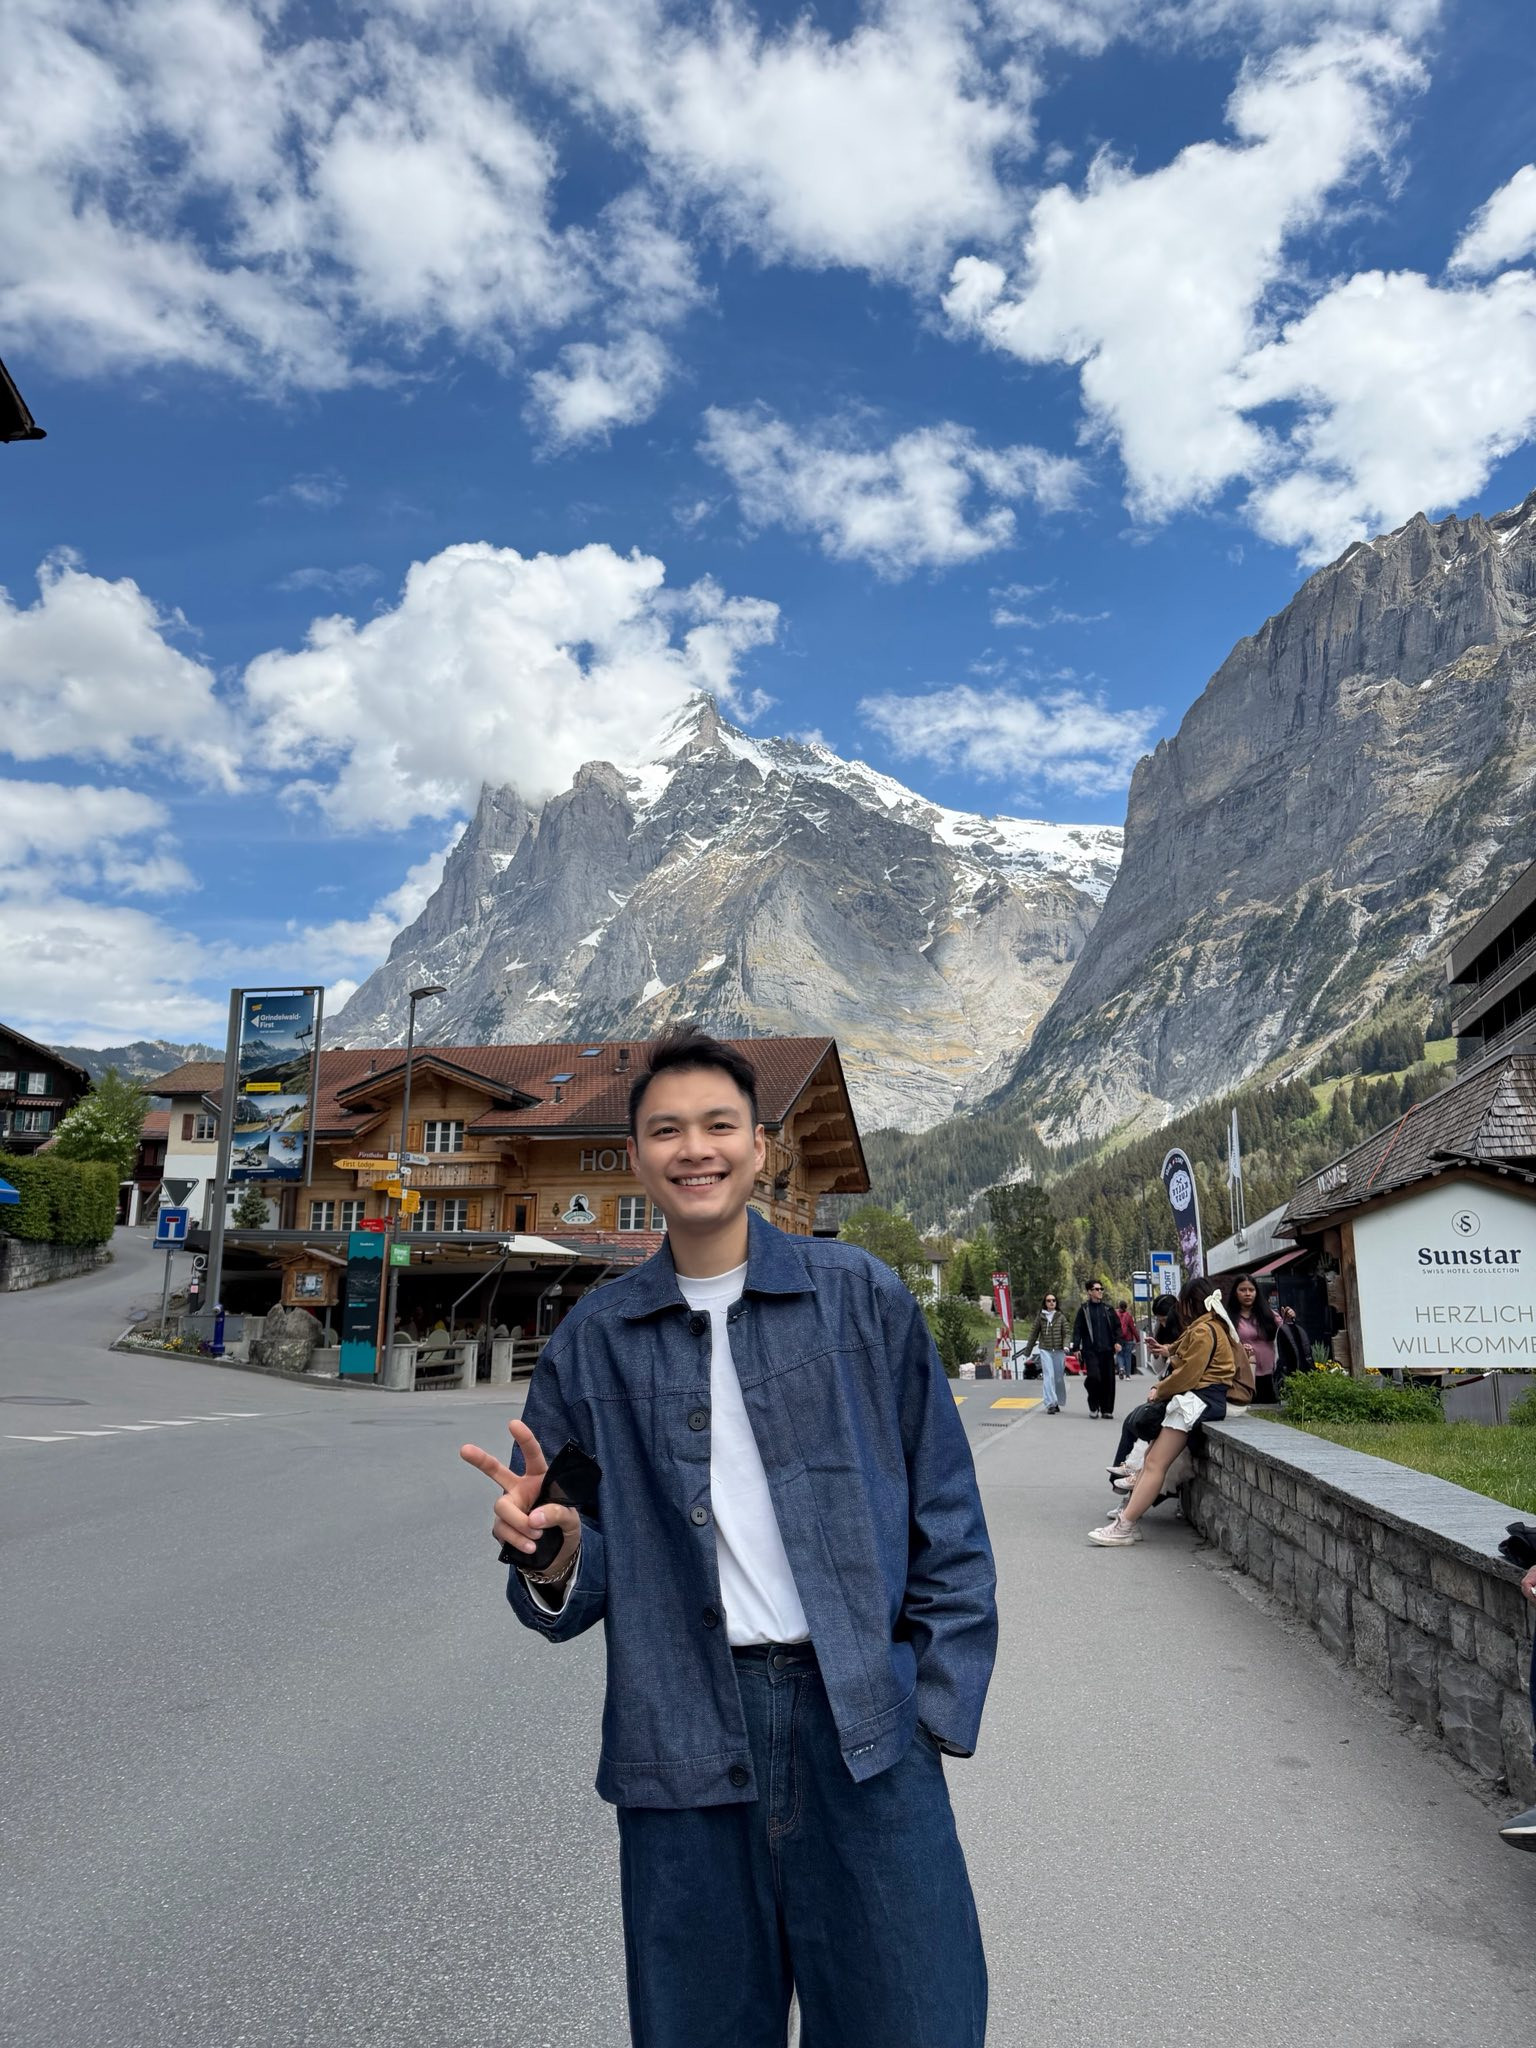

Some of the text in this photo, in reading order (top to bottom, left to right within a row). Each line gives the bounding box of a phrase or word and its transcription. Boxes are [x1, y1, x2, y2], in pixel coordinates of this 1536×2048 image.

[357, 1161, 375, 1169] Lodge
[1418, 1246, 1522, 1266] Sunstar
[1415, 1305, 1534, 1323] HERZLICH
